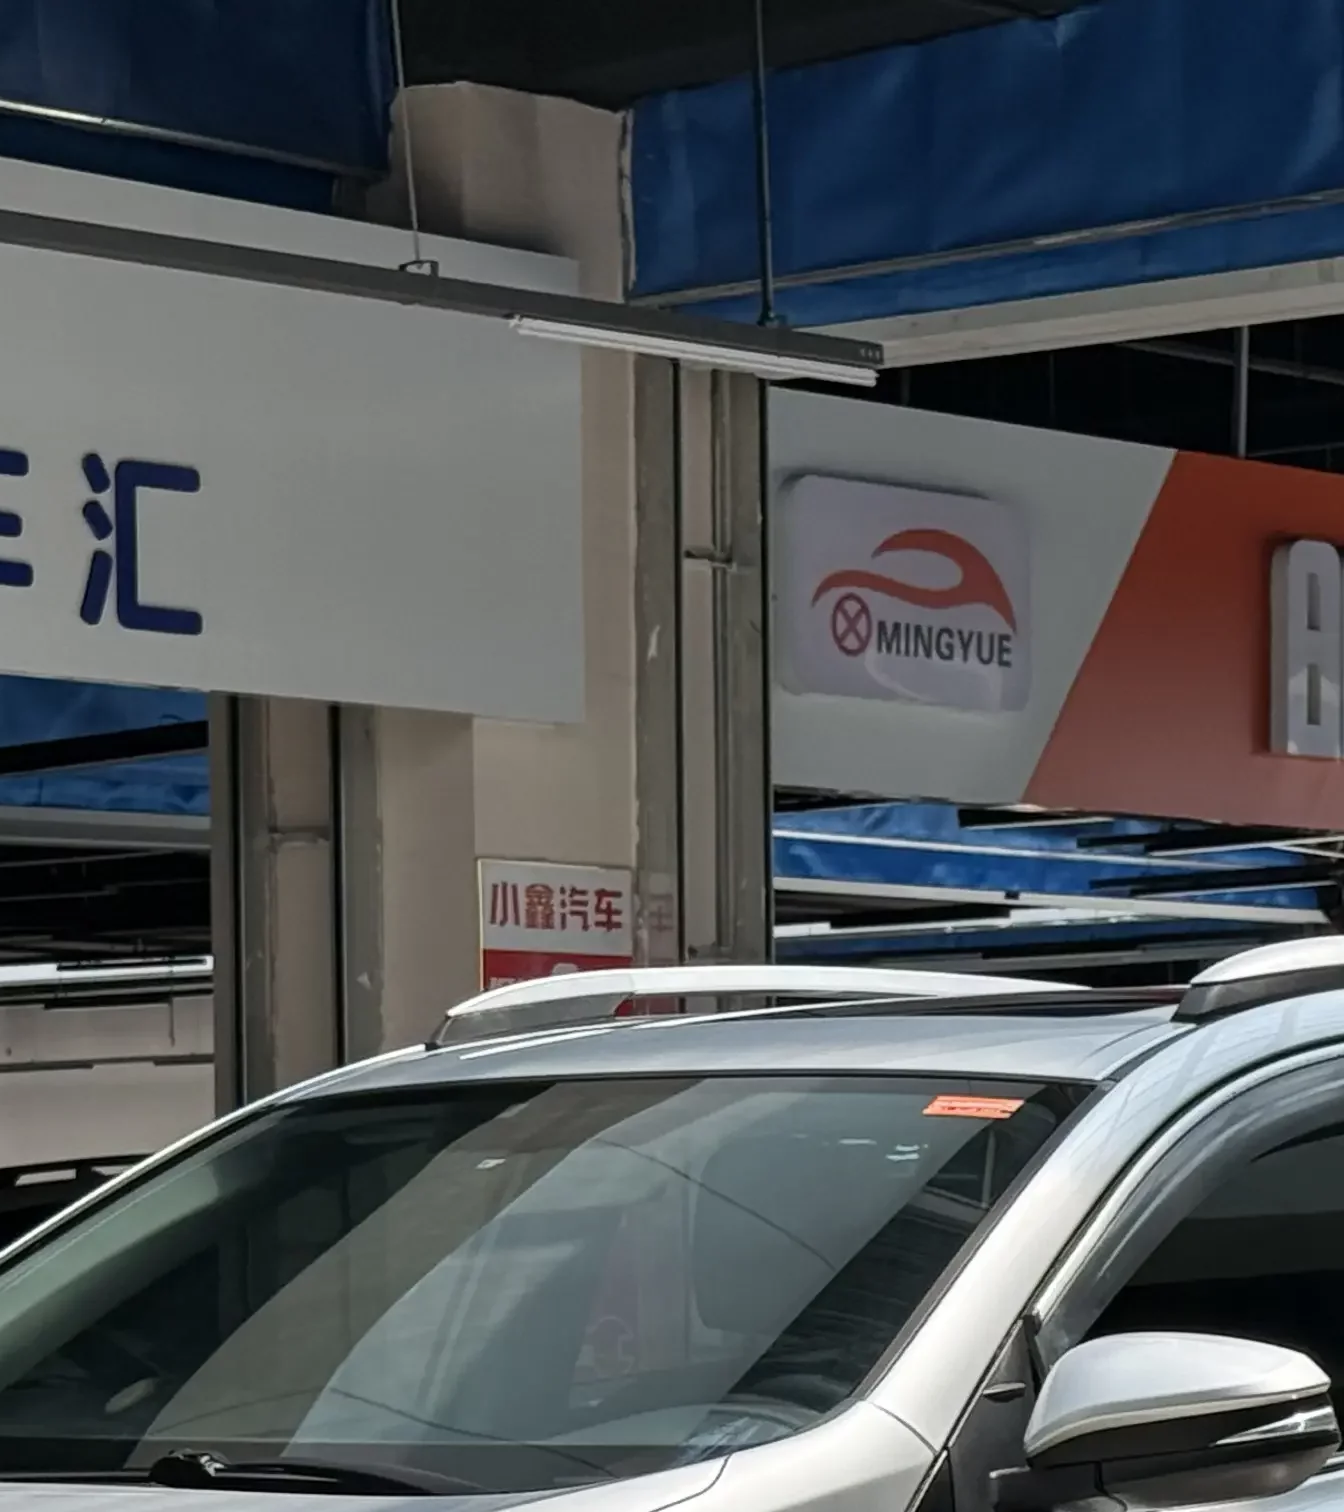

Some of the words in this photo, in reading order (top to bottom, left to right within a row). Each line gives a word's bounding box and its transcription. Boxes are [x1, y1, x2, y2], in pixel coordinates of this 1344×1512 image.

[876, 620, 1013, 668] MINGYUE
[489, 881, 623, 932] 小鑫汽车
